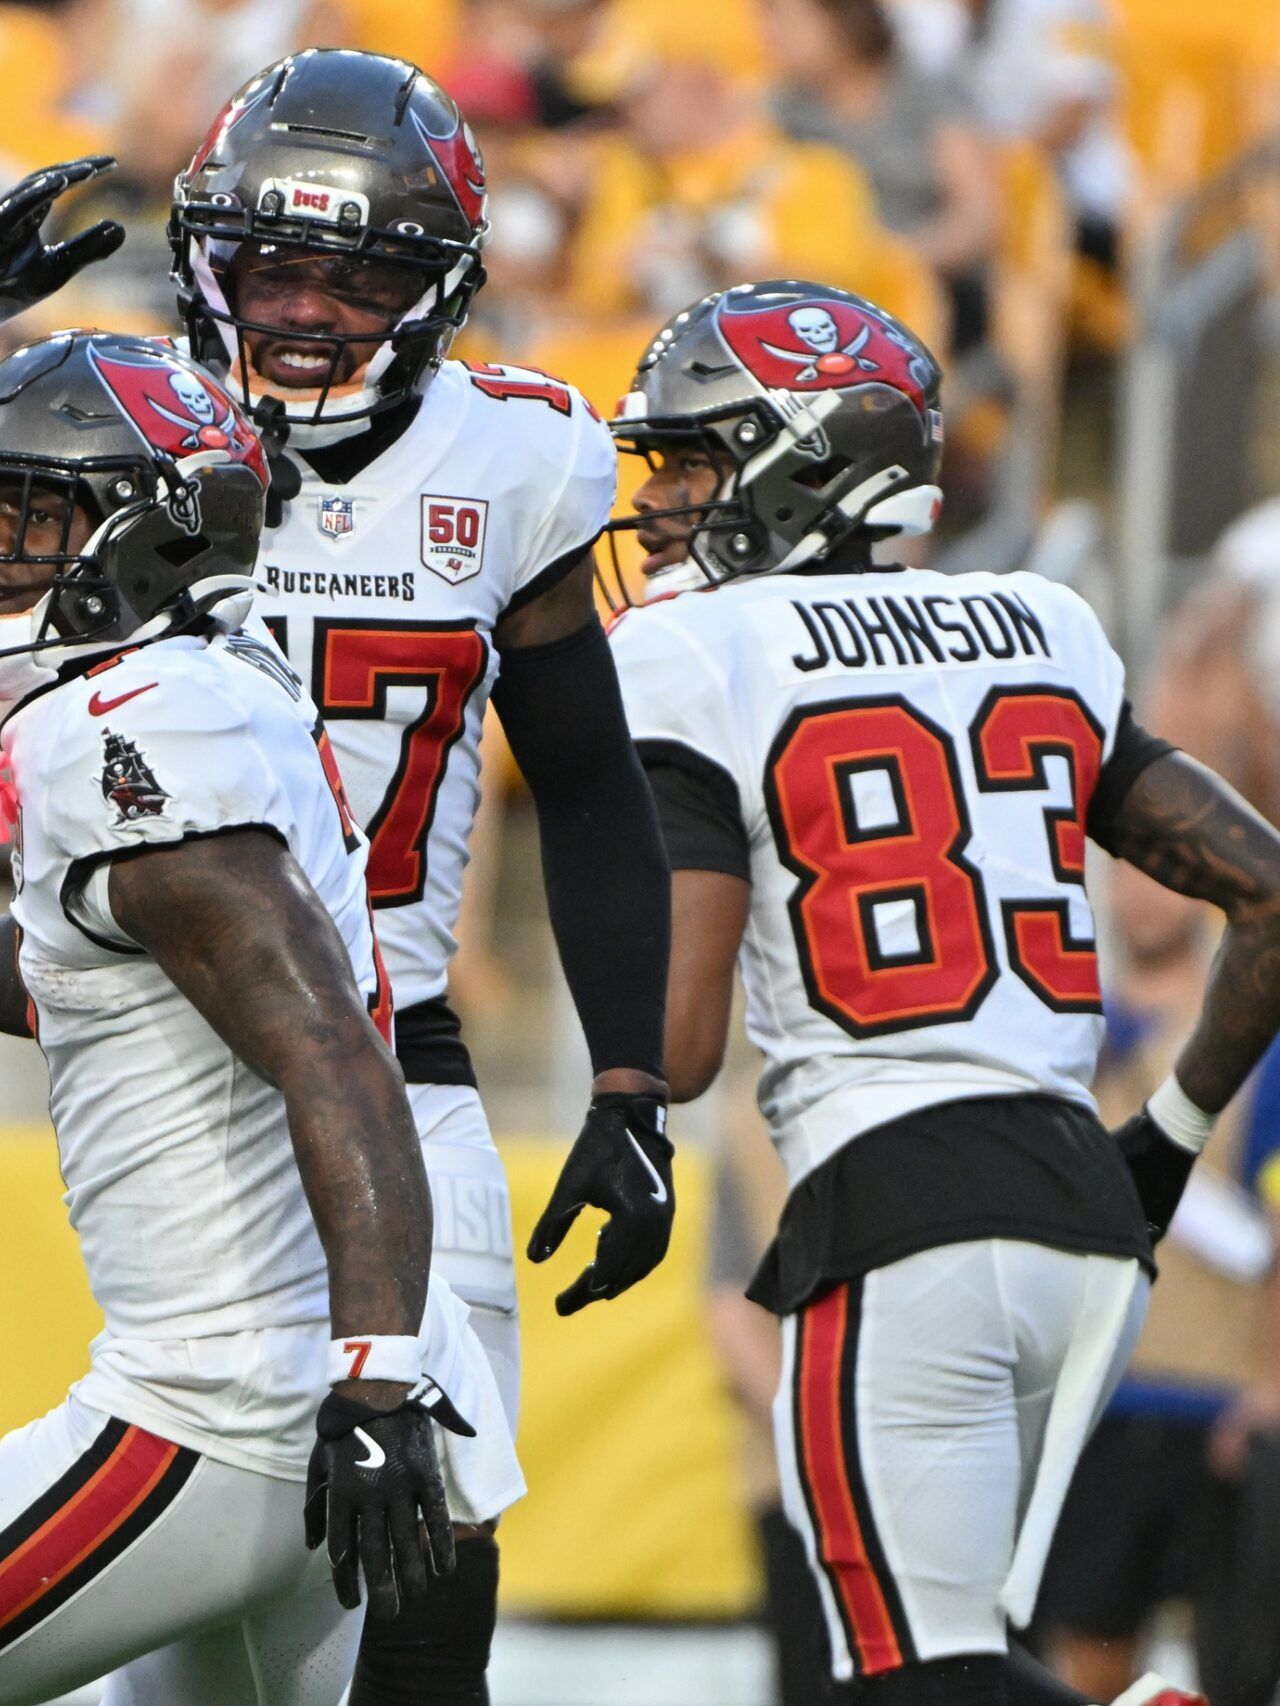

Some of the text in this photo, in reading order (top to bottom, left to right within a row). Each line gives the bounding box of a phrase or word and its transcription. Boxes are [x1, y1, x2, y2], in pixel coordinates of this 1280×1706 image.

[325, 513, 352, 532] NFL
[429, 504, 479, 548] 50
[264, 564, 415, 602] BUCCANEERS
[789, 590, 1052, 672] JOHNSON
[261, 615, 489, 910] 7
[763, 683, 1106, 1040] 83
[344, 1341, 372, 1379] 7
